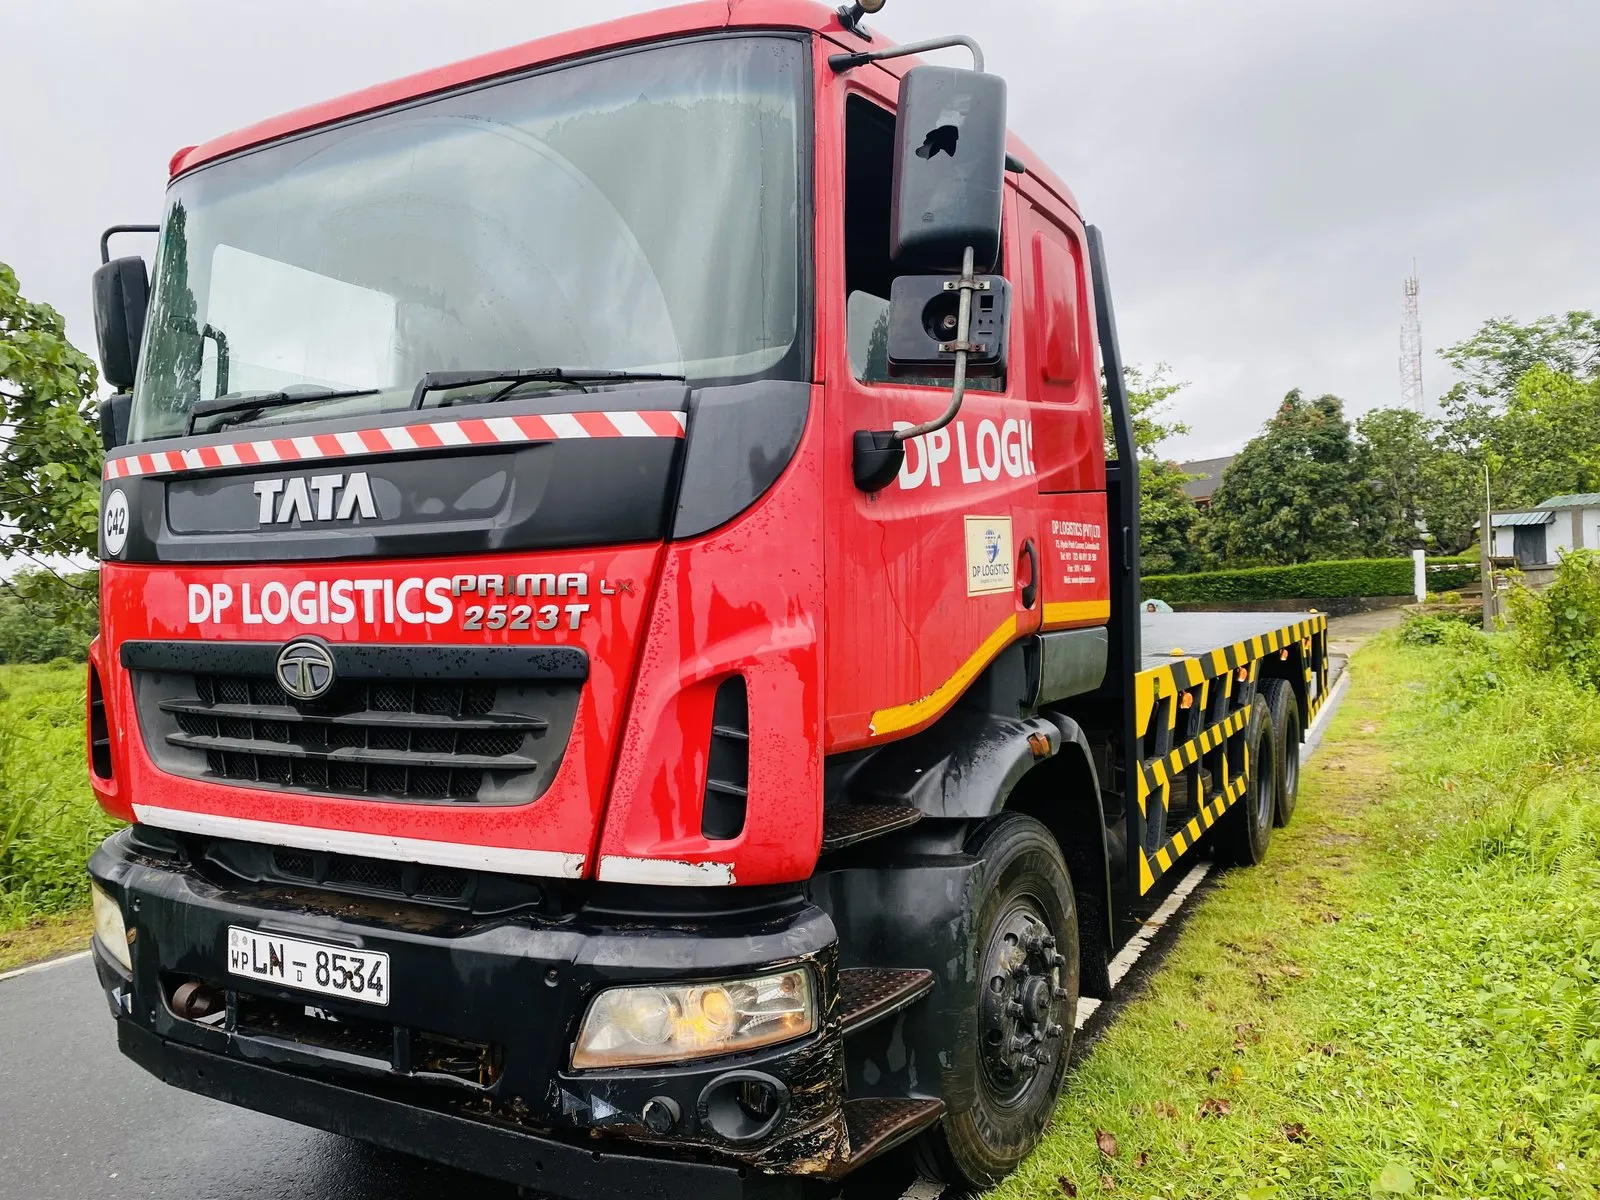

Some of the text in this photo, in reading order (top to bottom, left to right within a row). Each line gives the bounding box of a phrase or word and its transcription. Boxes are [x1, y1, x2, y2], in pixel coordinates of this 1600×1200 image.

[893, 421, 950, 490] DP
[253, 472, 378, 524] TATA
[106, 507, 126, 537] C42
[451, 572, 588, 597] PRIMA
[972, 563, 1010, 578] DP LOGISTICS
[187, 577, 454, 624] DP LOGISTICS
[463, 604, 590, 631] 2523T
[231, 949, 249, 971] WP
[315, 950, 384, 998] 8534
